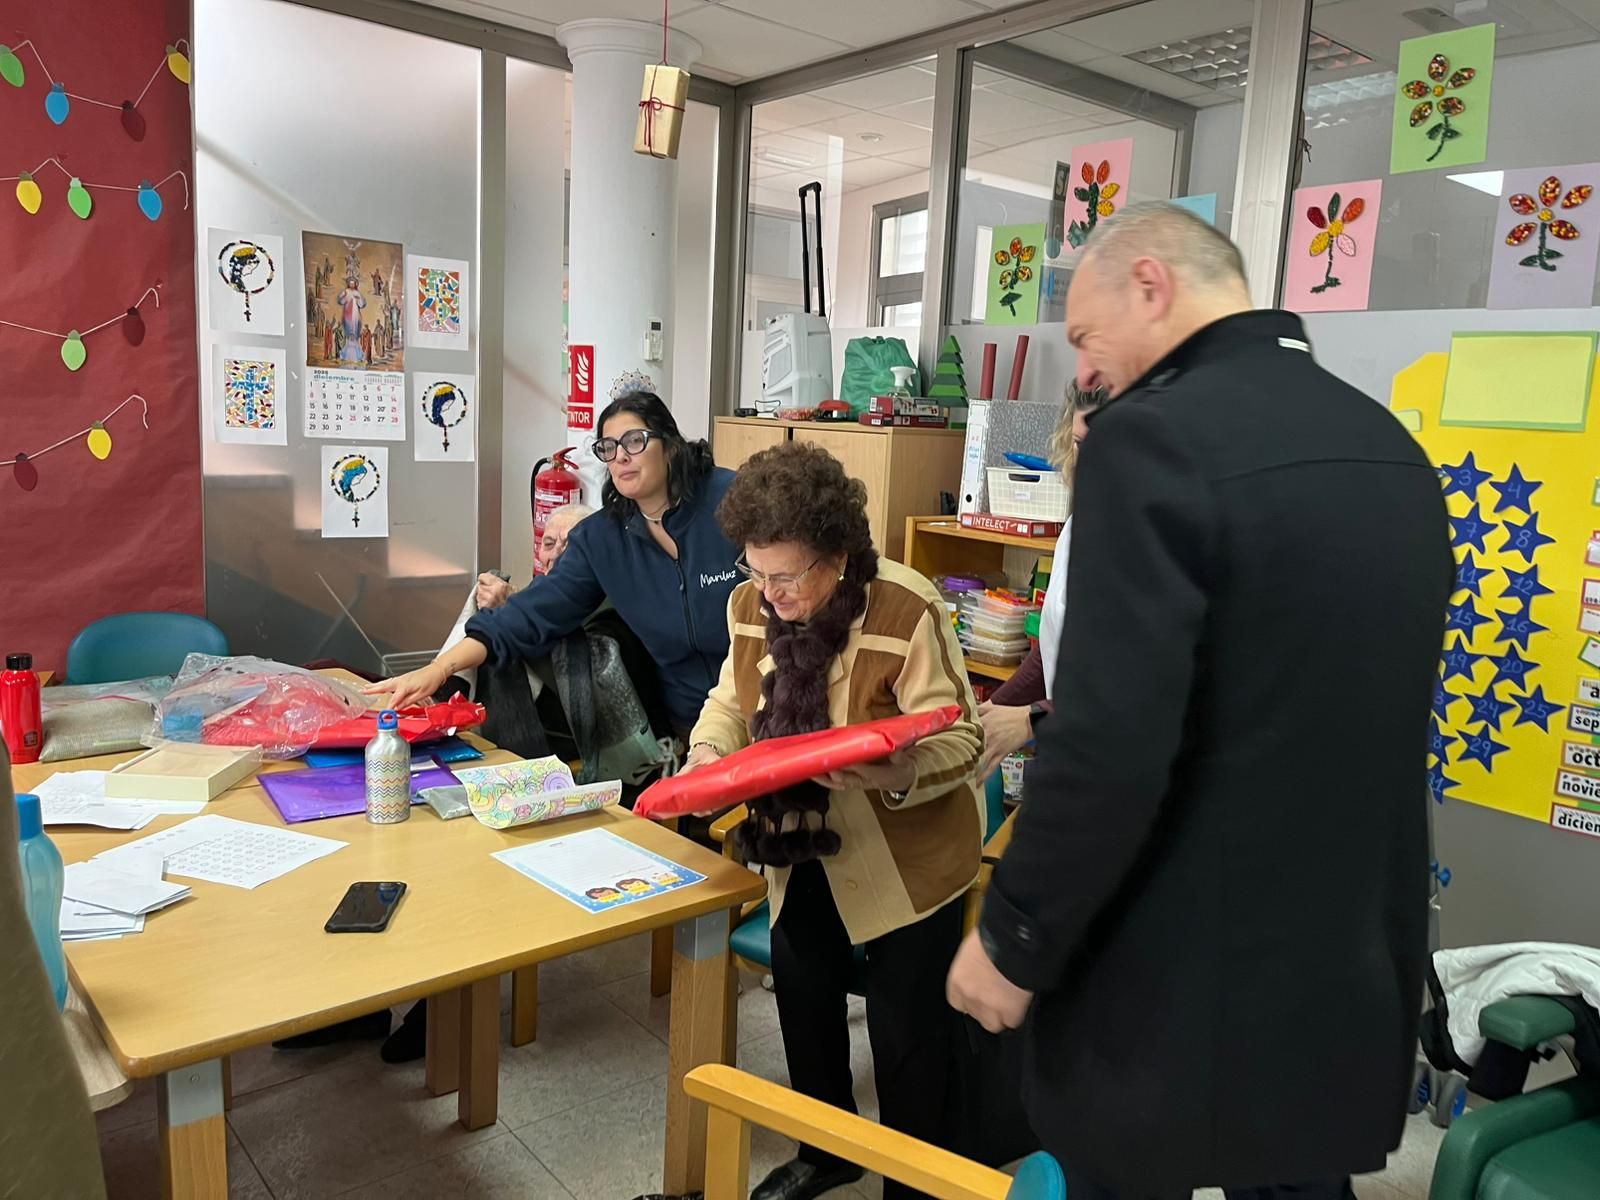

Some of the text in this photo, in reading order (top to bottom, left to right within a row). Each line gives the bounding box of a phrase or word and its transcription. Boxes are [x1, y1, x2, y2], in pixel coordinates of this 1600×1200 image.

[1459, 469, 1471, 486] 3
[1508, 482, 1520, 499] 4
[972, 517, 1010, 530] INTELECT
[1465, 521, 1477, 538] 7
[1516, 529, 1532, 548] 8
[700, 570, 736, 589] Mariluz
[1457, 567, 1477, 585] 11
[1512, 576, 1534, 596] 12
[1451, 609, 1474, 626] 15
[1506, 618, 1530, 633] 16
[1449, 653, 1467, 669] 19
[1500, 658, 1524, 674] 20
[1477, 700, 1499, 719] 24
[1524, 700, 1550, 719] 25
[1575, 716, 1600, 731] sep
[1469, 737, 1492, 758] 29
[1572, 752, 1600, 767] oct
